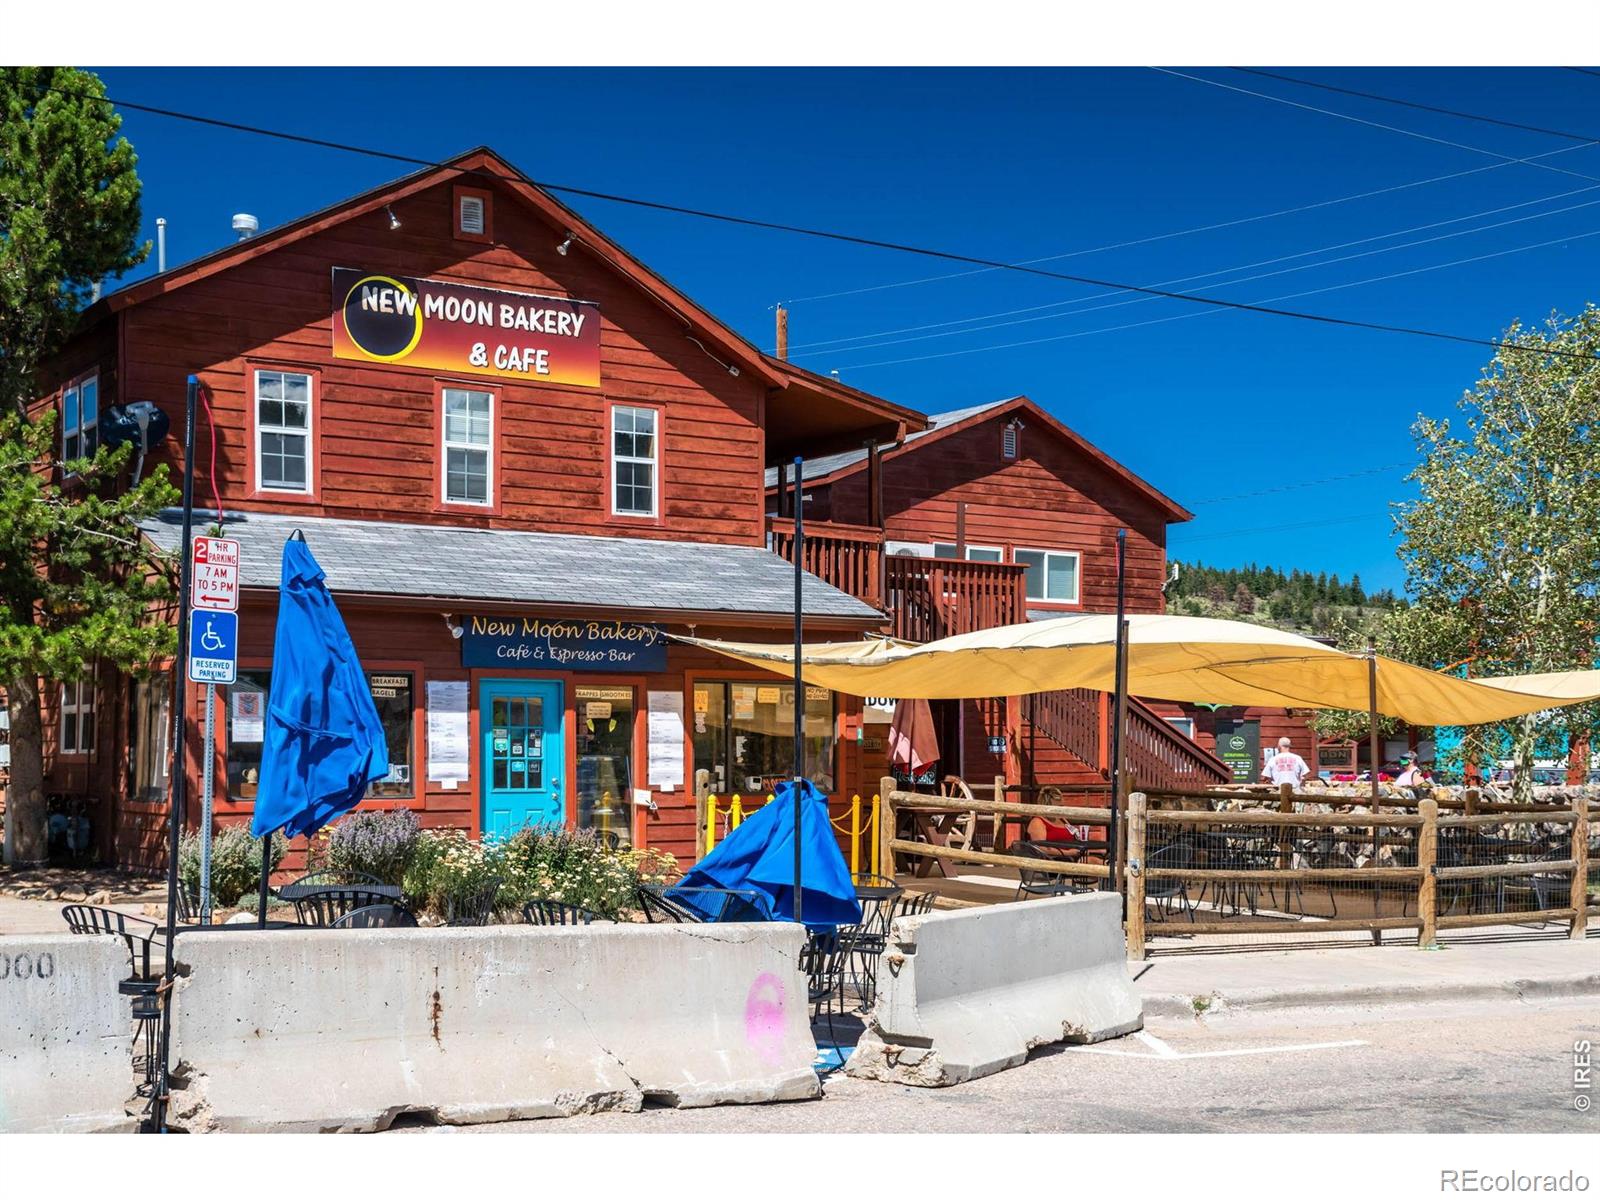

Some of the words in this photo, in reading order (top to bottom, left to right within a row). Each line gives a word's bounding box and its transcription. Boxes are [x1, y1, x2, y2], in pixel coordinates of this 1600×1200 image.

[361, 286, 418, 317] NEW
[424, 293, 493, 327] MOON
[499, 304, 585, 337] BAKERY
[469, 342, 489, 367] &
[494, 345, 550, 374] CAFE
[196, 542, 207, 558] 2
[217, 543, 229, 552] HR
[208, 553, 236, 565] PARKING
[205, 567, 211, 577] 7
[214, 568, 227, 578] AM
[197, 579, 208, 590] TO
[211, 581, 218, 591] 5
[221, 582, 234, 593] PM
[471, 616, 515, 637] New
[522, 618, 583, 639] Moon
[588, 622, 658, 647] Bakery
[497, 645, 532, 660] Café
[533, 648, 545, 660] &
[550, 648, 606, 663] Espresso
[608, 649, 636, 662] Bar
[196, 660, 230, 670] RESERVED
[199, 669, 226, 678] PARKING
[372, 678, 407, 686] BREAKFAST
